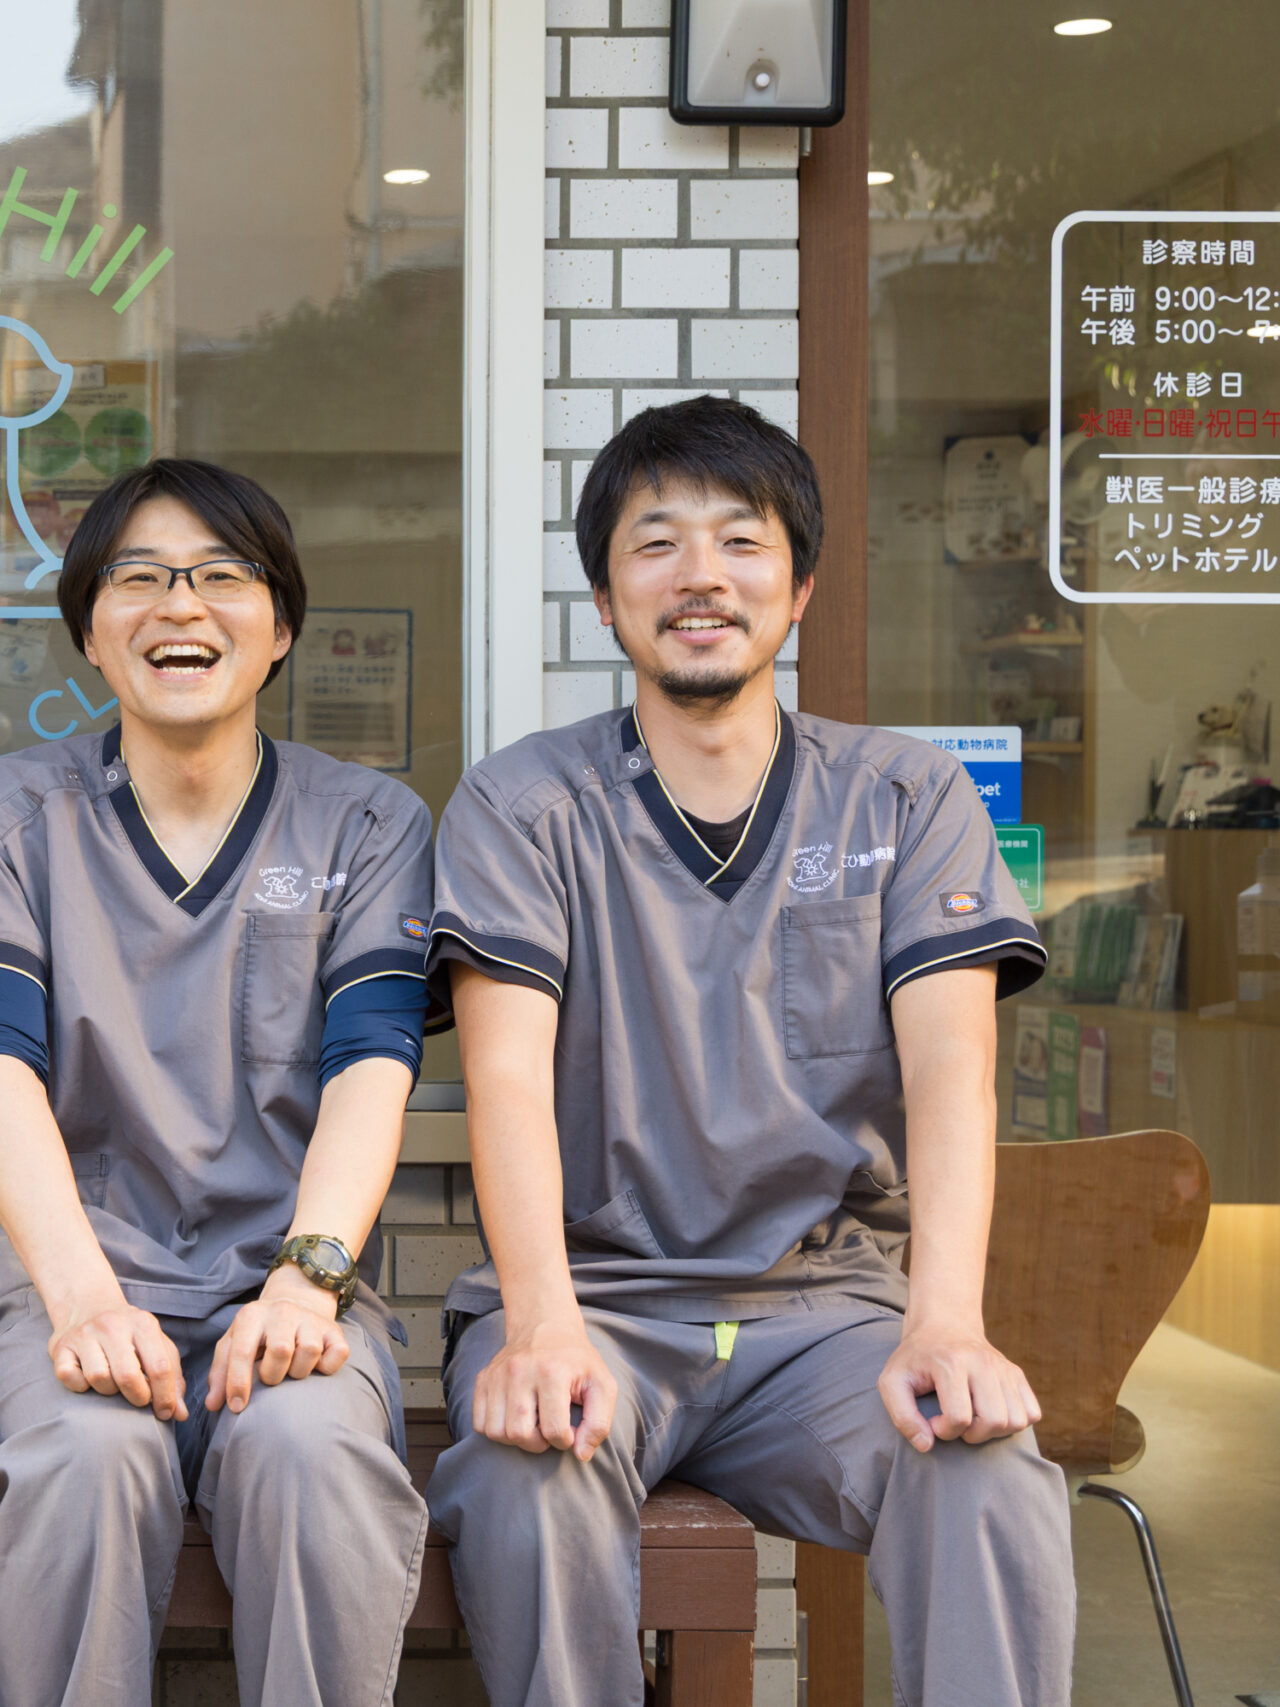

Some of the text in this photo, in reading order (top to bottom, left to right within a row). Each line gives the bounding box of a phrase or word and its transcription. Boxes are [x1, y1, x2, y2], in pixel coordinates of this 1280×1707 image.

[1142, 239, 1255, 266] 診察時間
[1081, 285, 1136, 313] 午前
[1081, 318, 1136, 346] 午後
[1153, 371, 1242, 398] 休診日
[1105, 475, 1280, 504] 獣医一般診療
[1128, 512, 1265, 539] トリミング
[1114, 546, 1279, 573] ペットホテル
[972, 778, 1001, 796] pet
[258, 866, 286, 877] Green
